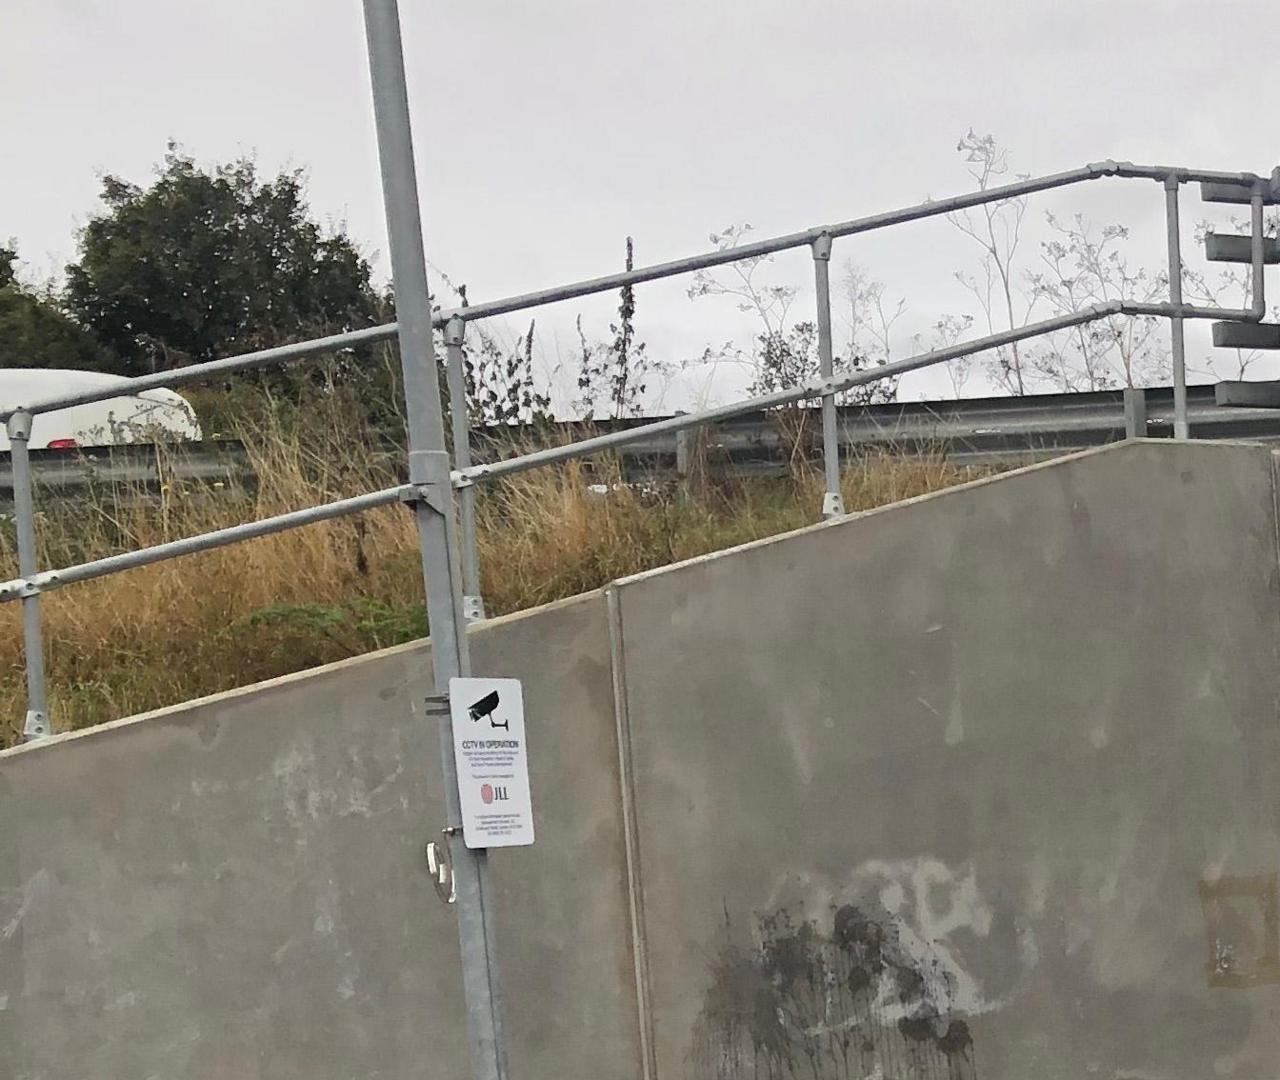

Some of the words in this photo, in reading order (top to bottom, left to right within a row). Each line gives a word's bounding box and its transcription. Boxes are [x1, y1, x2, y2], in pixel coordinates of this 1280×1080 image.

[462, 740, 478, 749] CCTV
[486, 740, 519, 749] OPERATION
[494, 786, 509, 801] JLL
